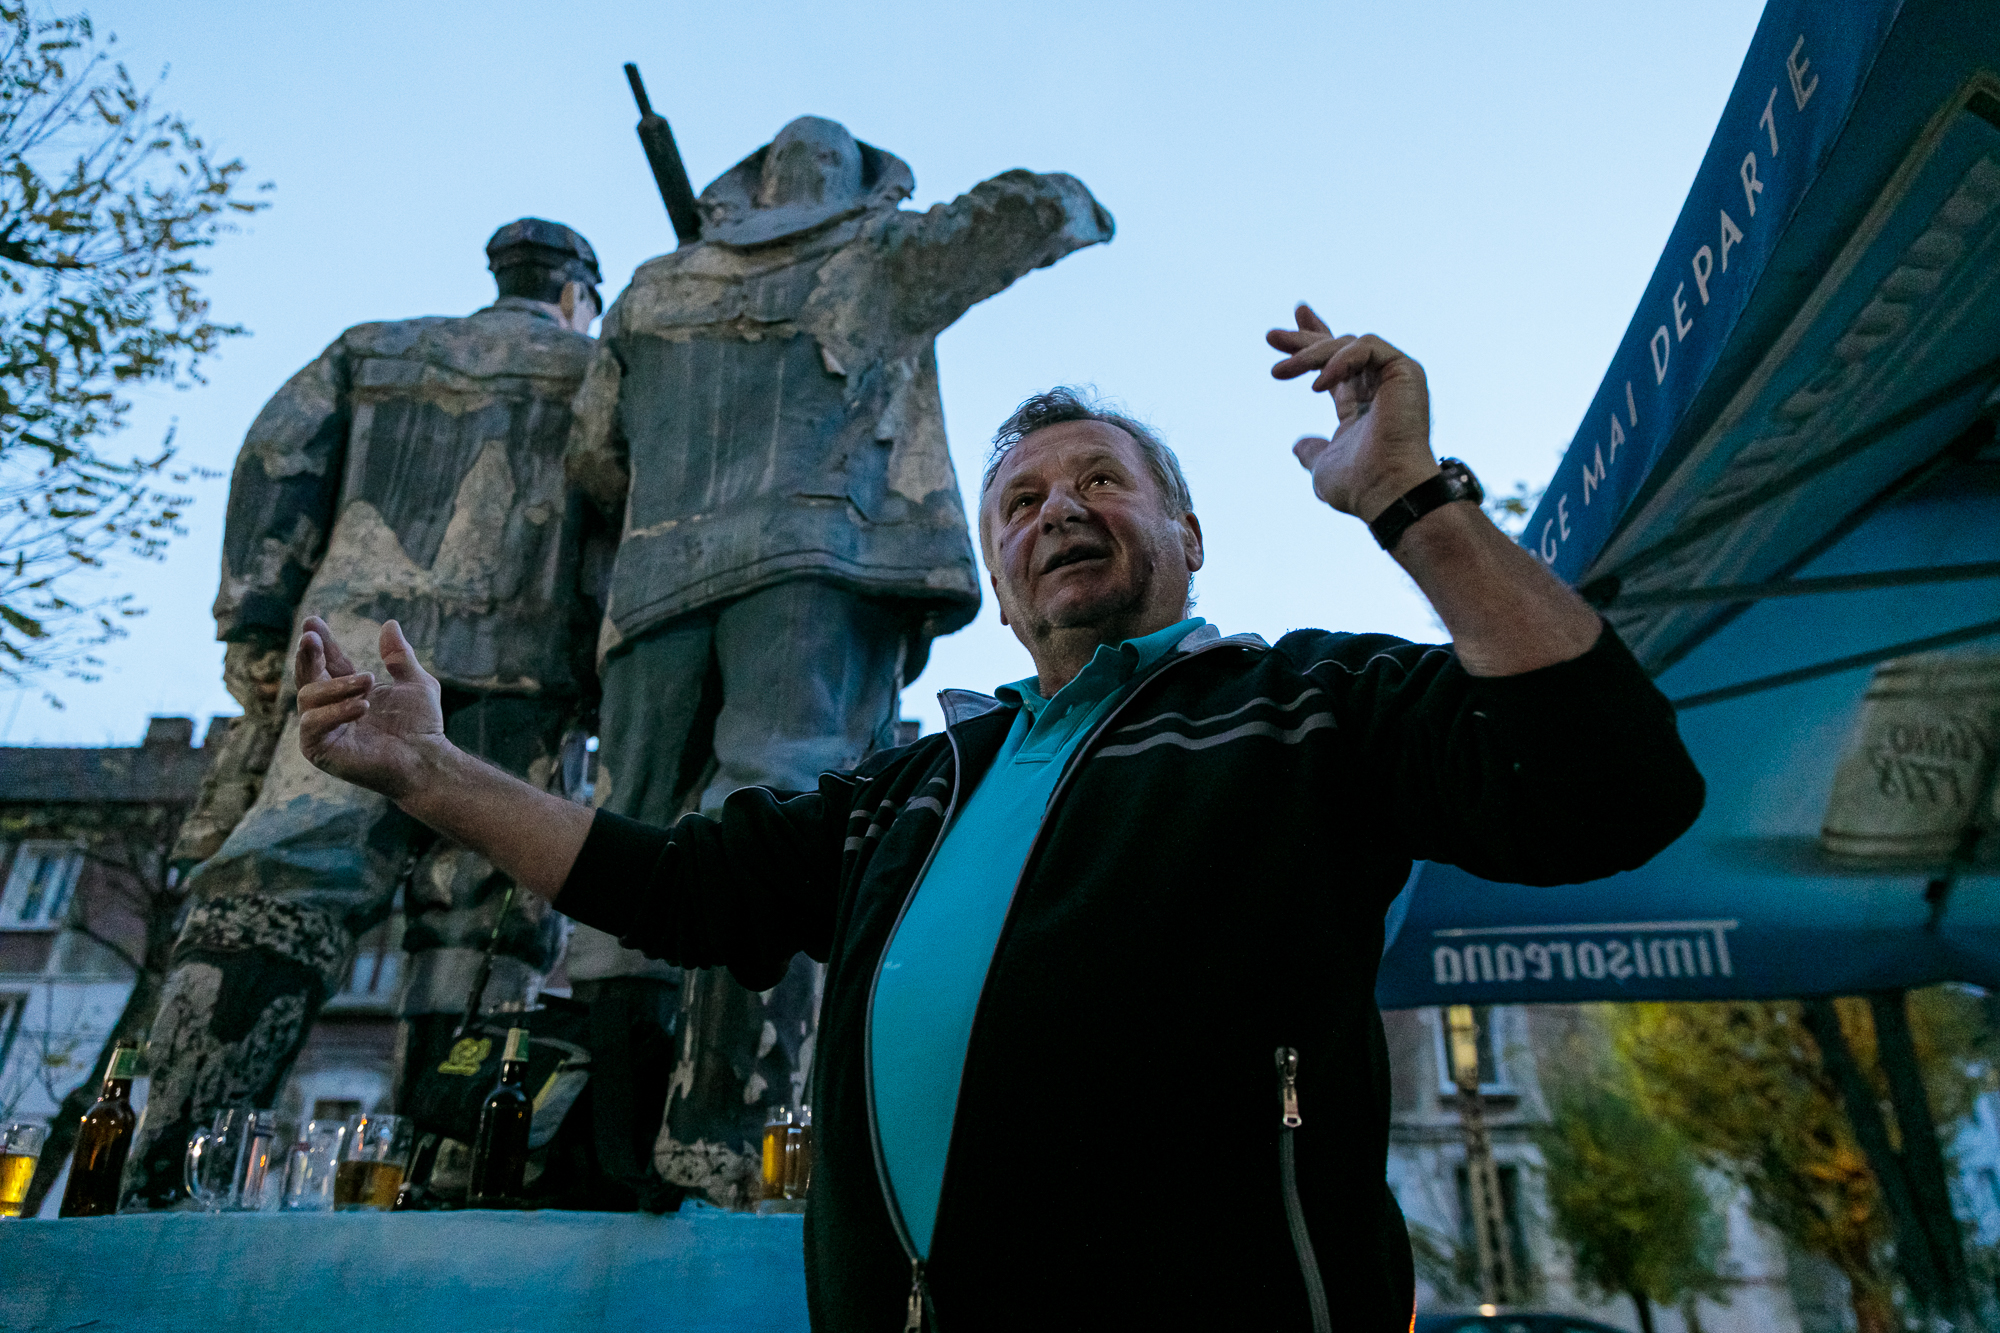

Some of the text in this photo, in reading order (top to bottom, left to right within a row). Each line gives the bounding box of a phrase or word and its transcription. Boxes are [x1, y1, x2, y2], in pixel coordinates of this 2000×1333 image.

[1530, 34, 1819, 565] GE MAI DEPARTE
